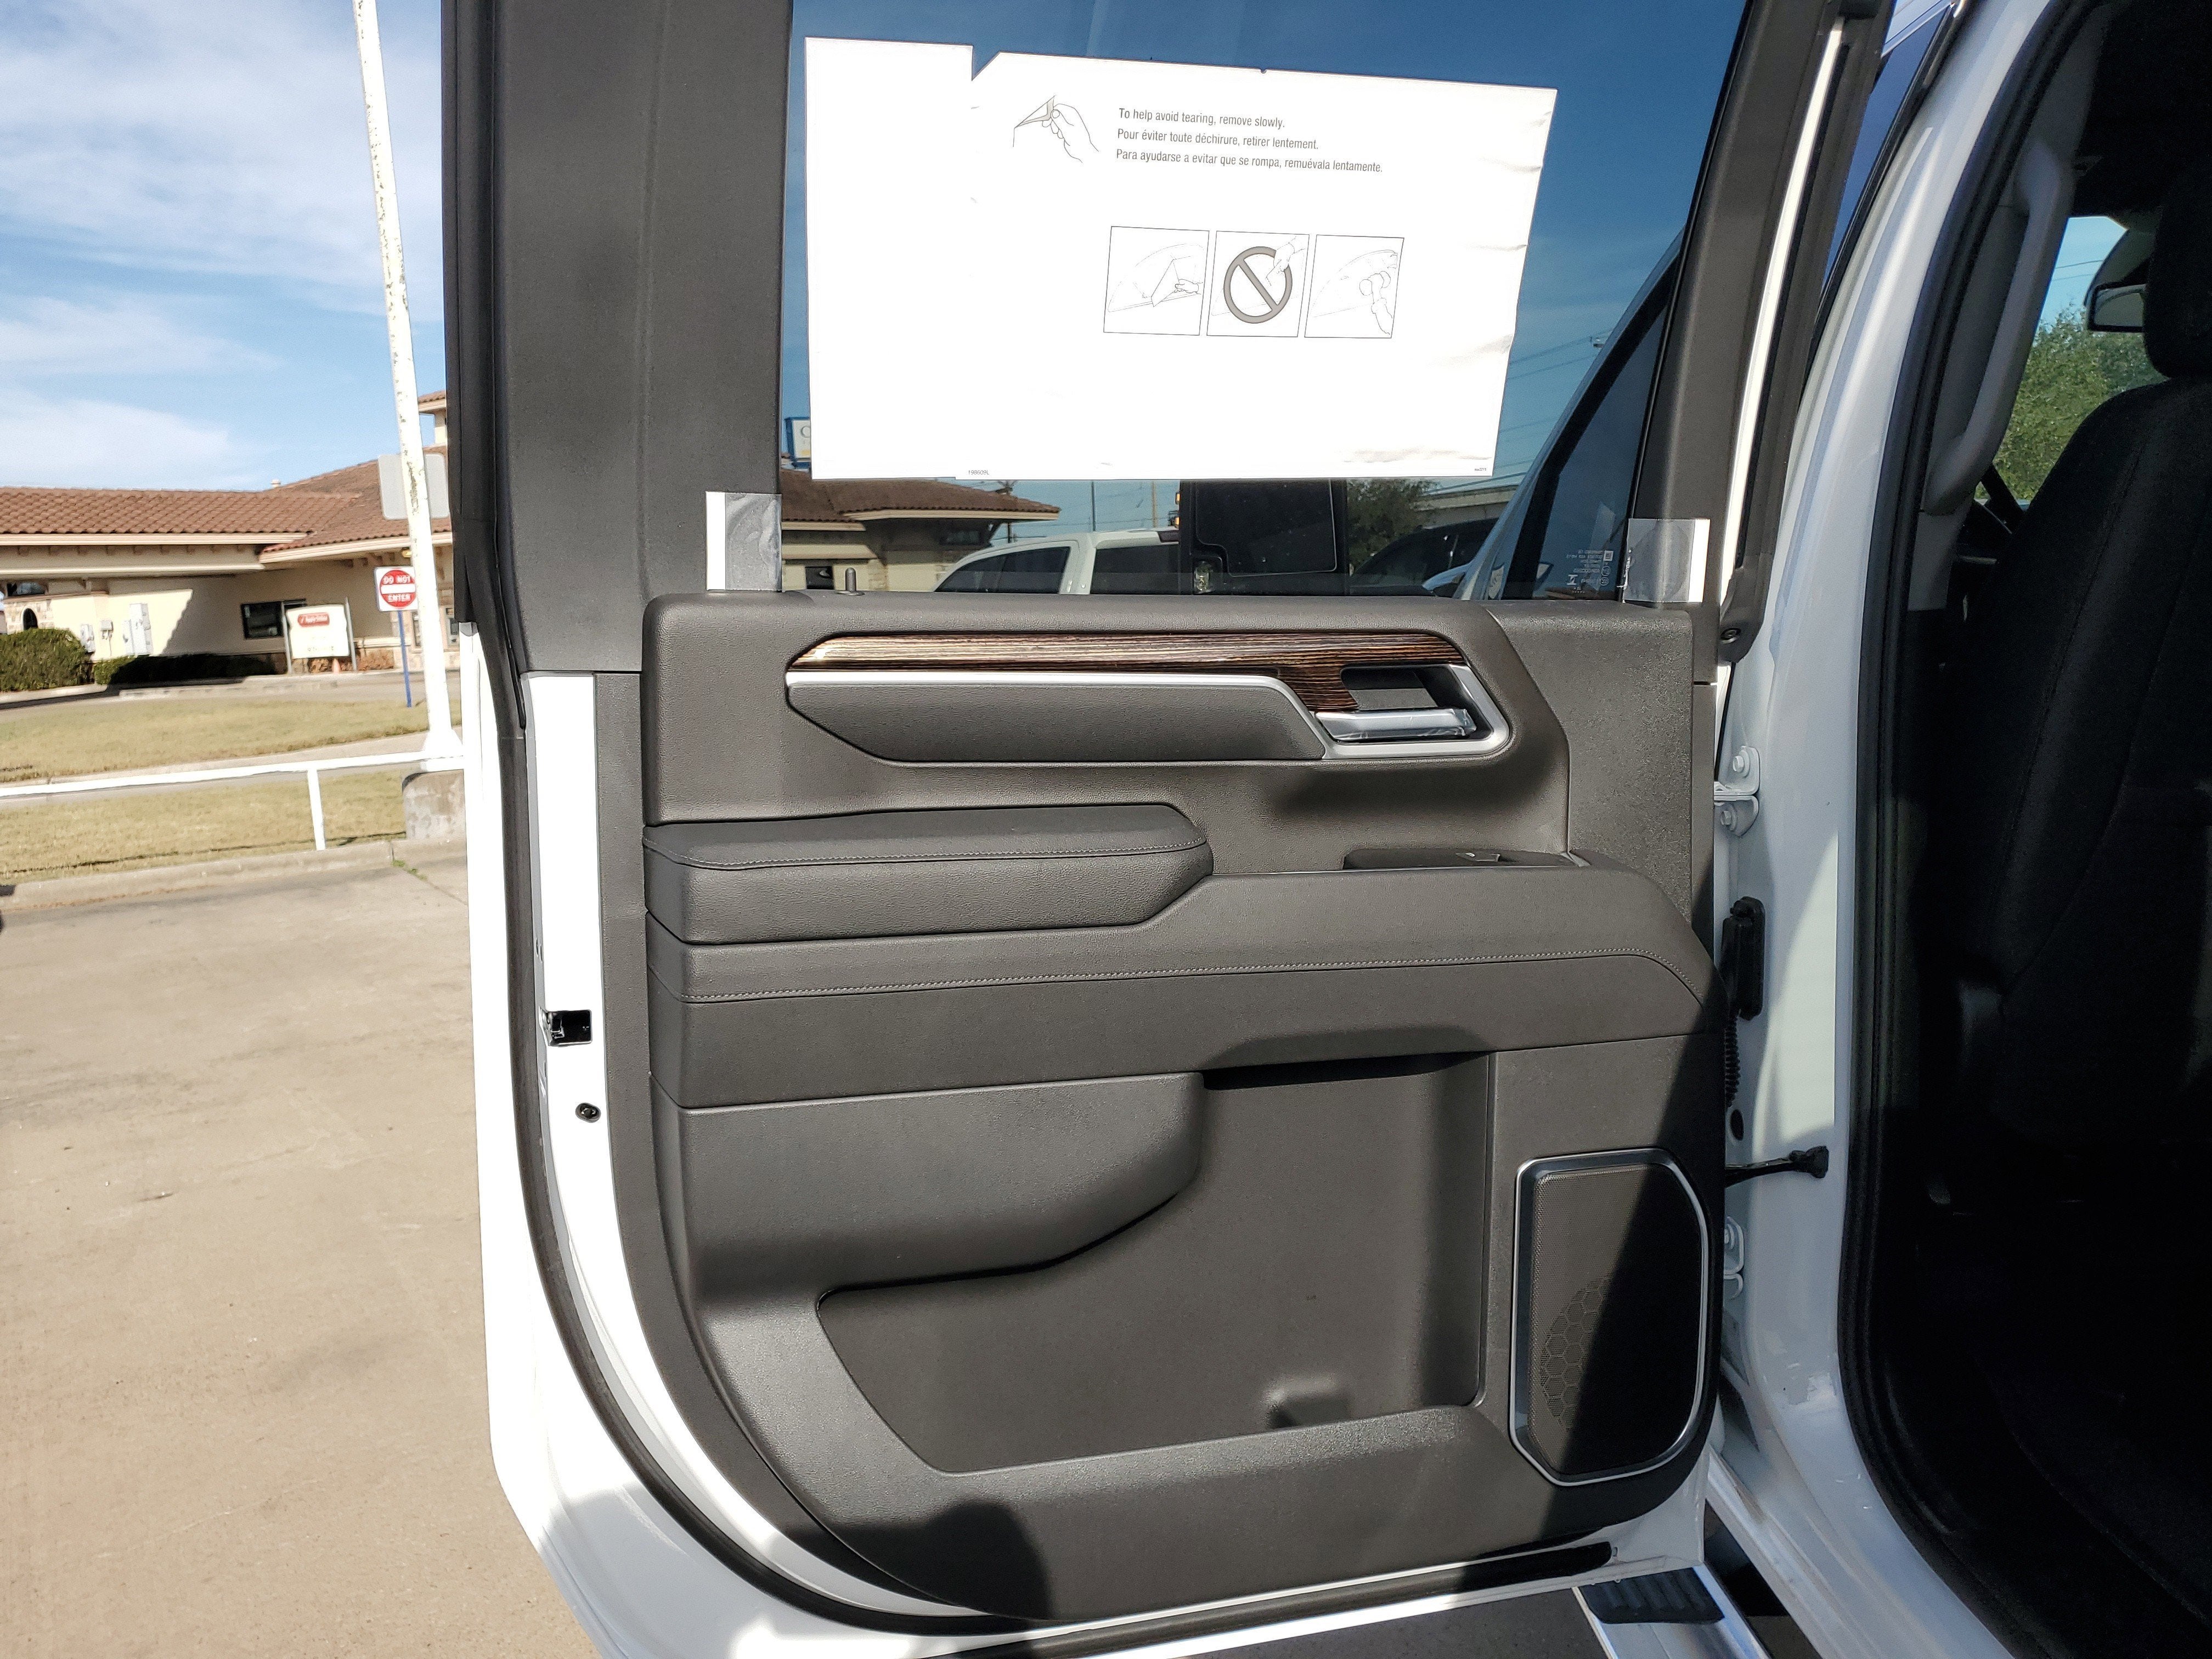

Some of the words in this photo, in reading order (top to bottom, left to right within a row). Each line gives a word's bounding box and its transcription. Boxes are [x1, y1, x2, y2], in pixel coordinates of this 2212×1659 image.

[1119, 108, 1130, 119] To
[1133, 109, 1153, 122] help
[1155, 111, 1179, 122] avoid
[1181, 112, 1216, 126] tearing,
[1219, 116, 1252, 126] remove
[1255, 116, 1285, 130] slowly.
[1118, 128, 1139, 140] Pour
[1142, 129, 1167, 142] éviter
[1169, 131, 1192, 143] toute
[1195, 133, 1240, 146] déchirure,
[1243, 136, 1271, 147] retirer
[1272, 137, 1318, 150] lentement.
[1116, 148, 1138, 160] Para
[1140, 151, 1181, 163] ayudarse
[1184, 154, 1189, 163] a
[1192, 153, 1218, 164] evitar
[1220, 156, 1236, 167] que
[1238, 157, 1249, 166] se
[1251, 158, 1282, 169] rompa,
[1284, 158, 1330, 170] remuévala
[1333, 160, 1383, 172] lentamente.
[382, 575, 394, 584] DO
[397, 574, 411, 583] NOT
[387, 594, 411, 602] ENTER
